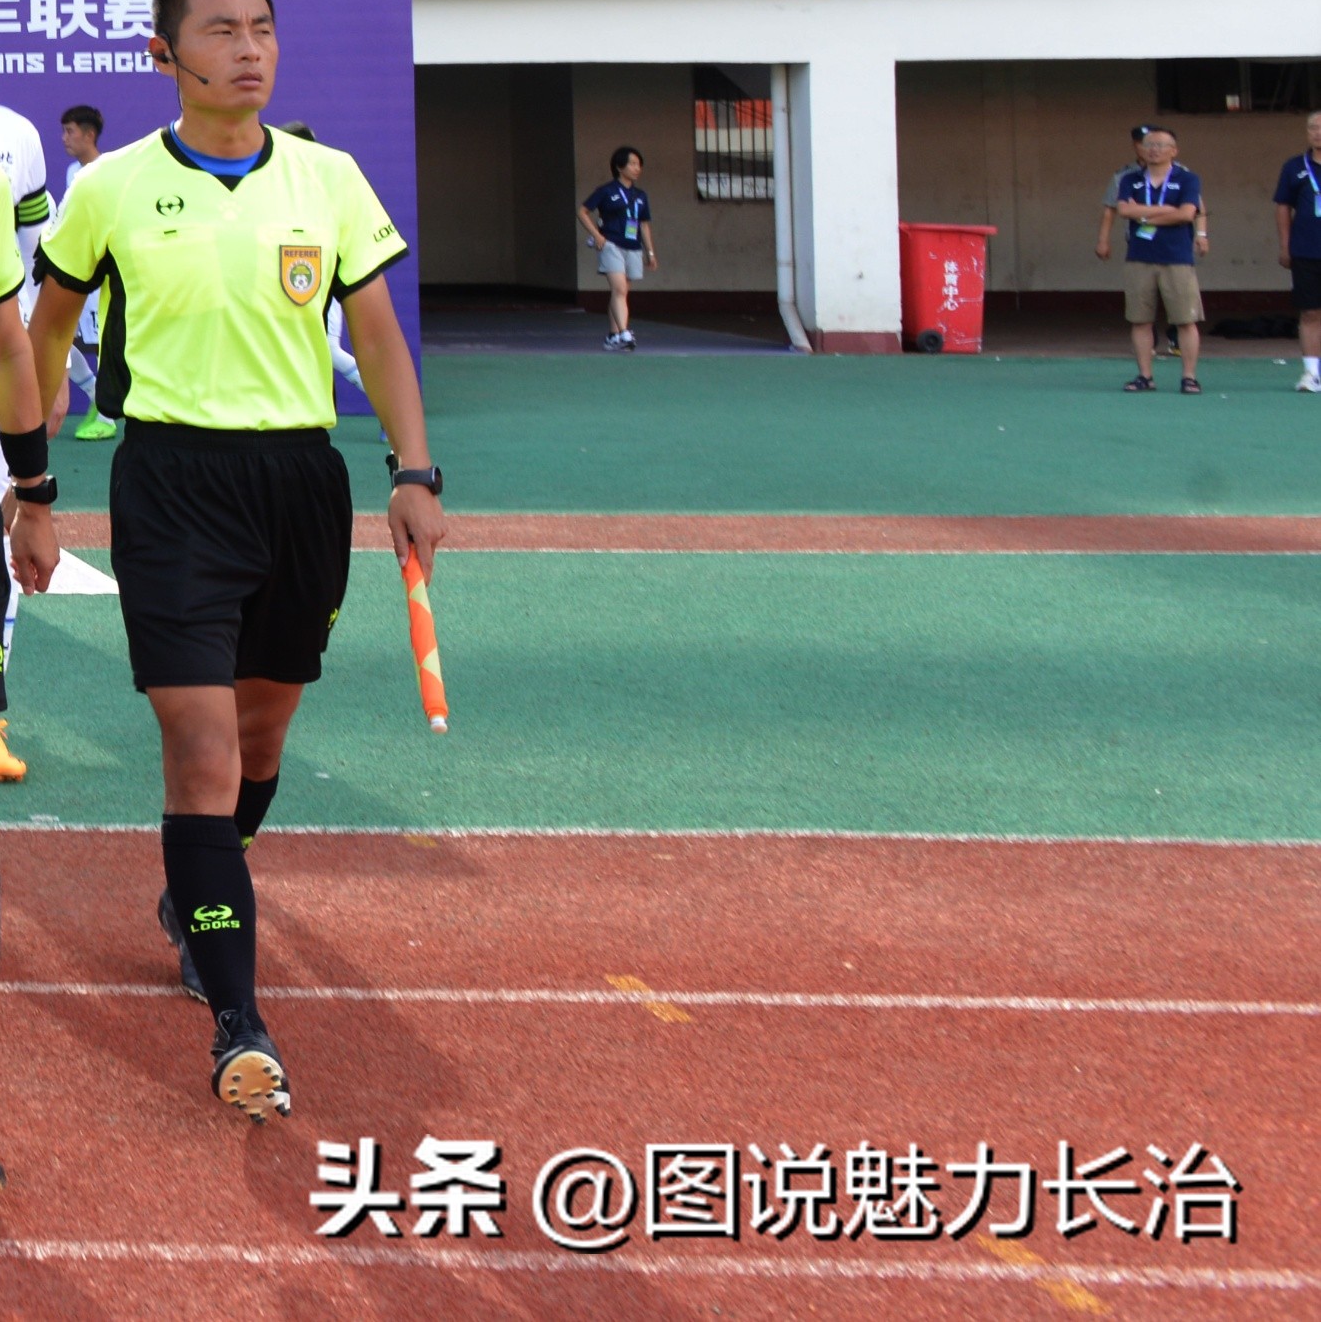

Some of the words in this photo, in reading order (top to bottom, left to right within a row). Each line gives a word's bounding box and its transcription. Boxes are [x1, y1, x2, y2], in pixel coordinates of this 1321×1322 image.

[57, 52, 158, 74] LEAGU
[284, 249, 319, 259] REFEREE
[190, 919, 241, 934] LOOKS
